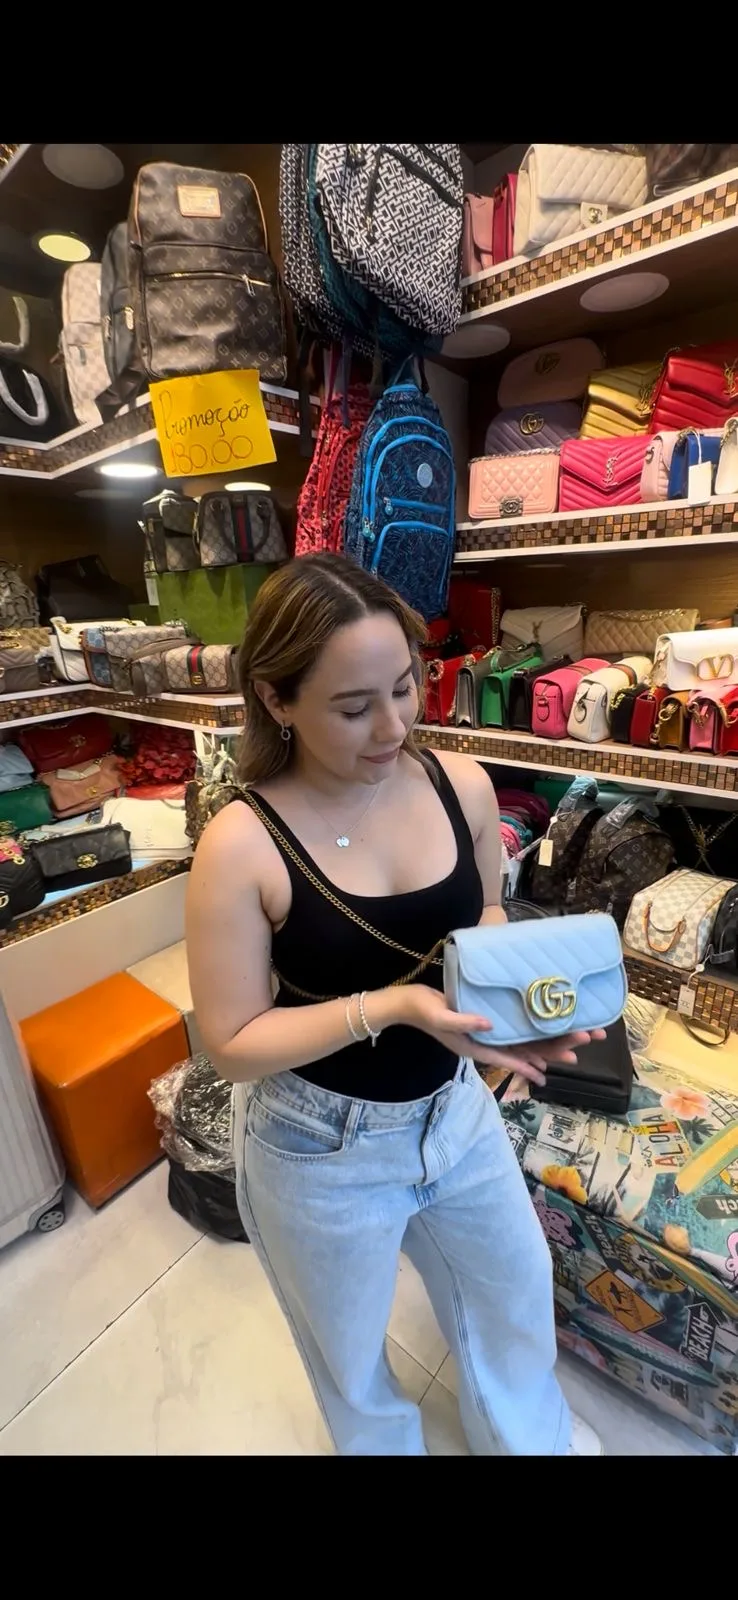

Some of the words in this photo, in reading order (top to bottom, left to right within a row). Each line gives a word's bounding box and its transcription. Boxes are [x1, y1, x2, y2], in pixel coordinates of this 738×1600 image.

[159, 390, 250, 439] Promoção
[642, 1113, 684, 1167] ALOHA
[688, 1316, 714, 1361] BEACH
